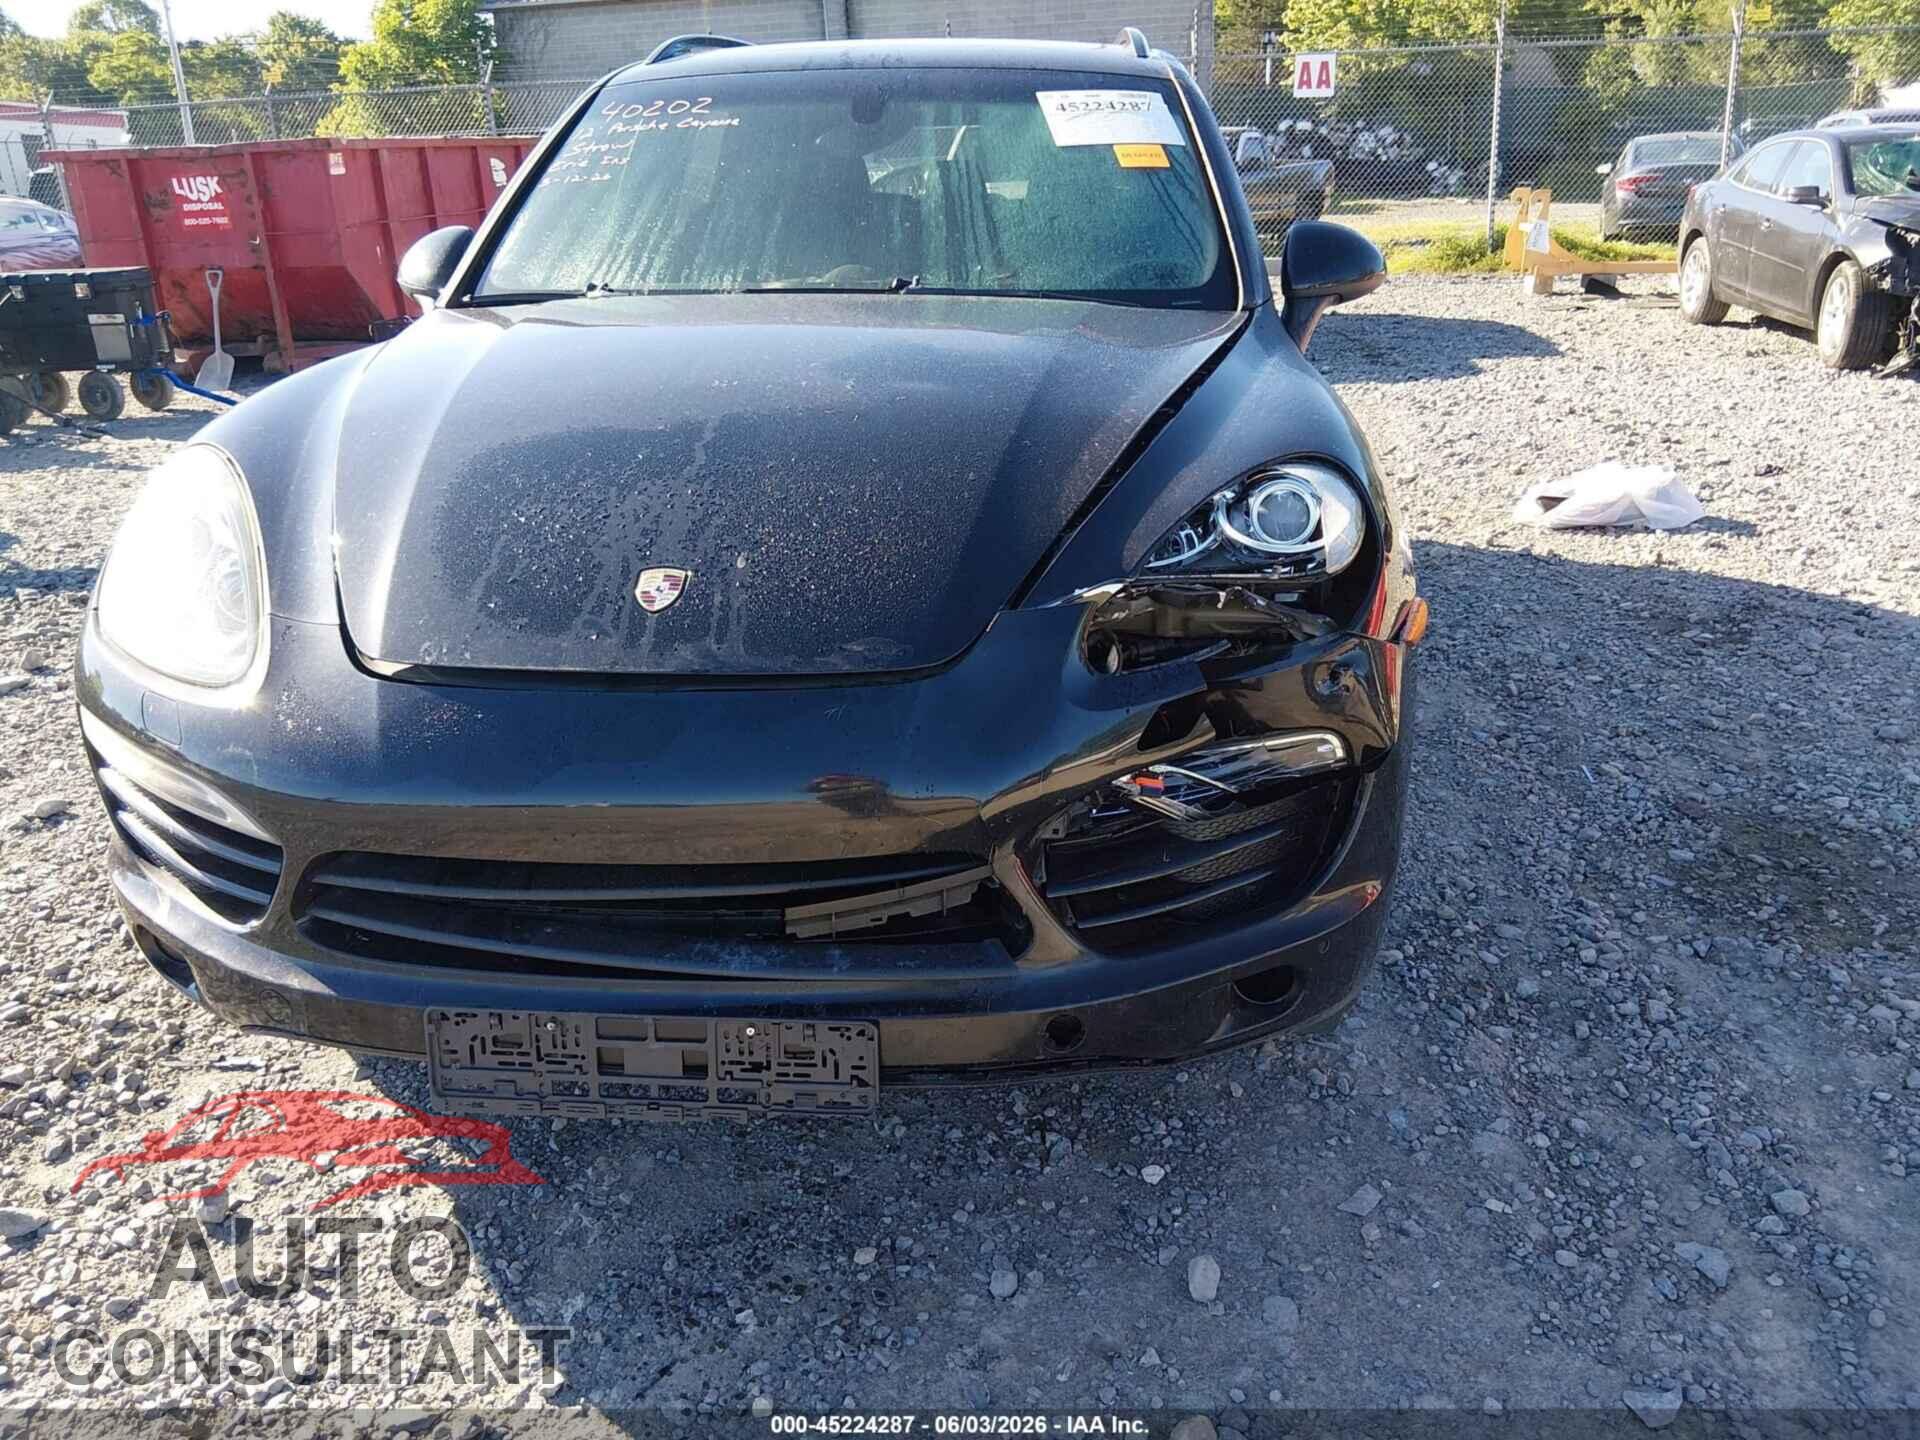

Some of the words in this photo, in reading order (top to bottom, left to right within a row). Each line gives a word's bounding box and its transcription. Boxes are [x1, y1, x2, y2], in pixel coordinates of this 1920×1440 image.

[1297, 61, 1331, 89] AA
[601, 97, 713, 122] 40202
[1056, 101, 1152, 112] 45224287
[172, 176, 223, 202] LUSK
[183, 202, 224, 211] DISPOSAL
